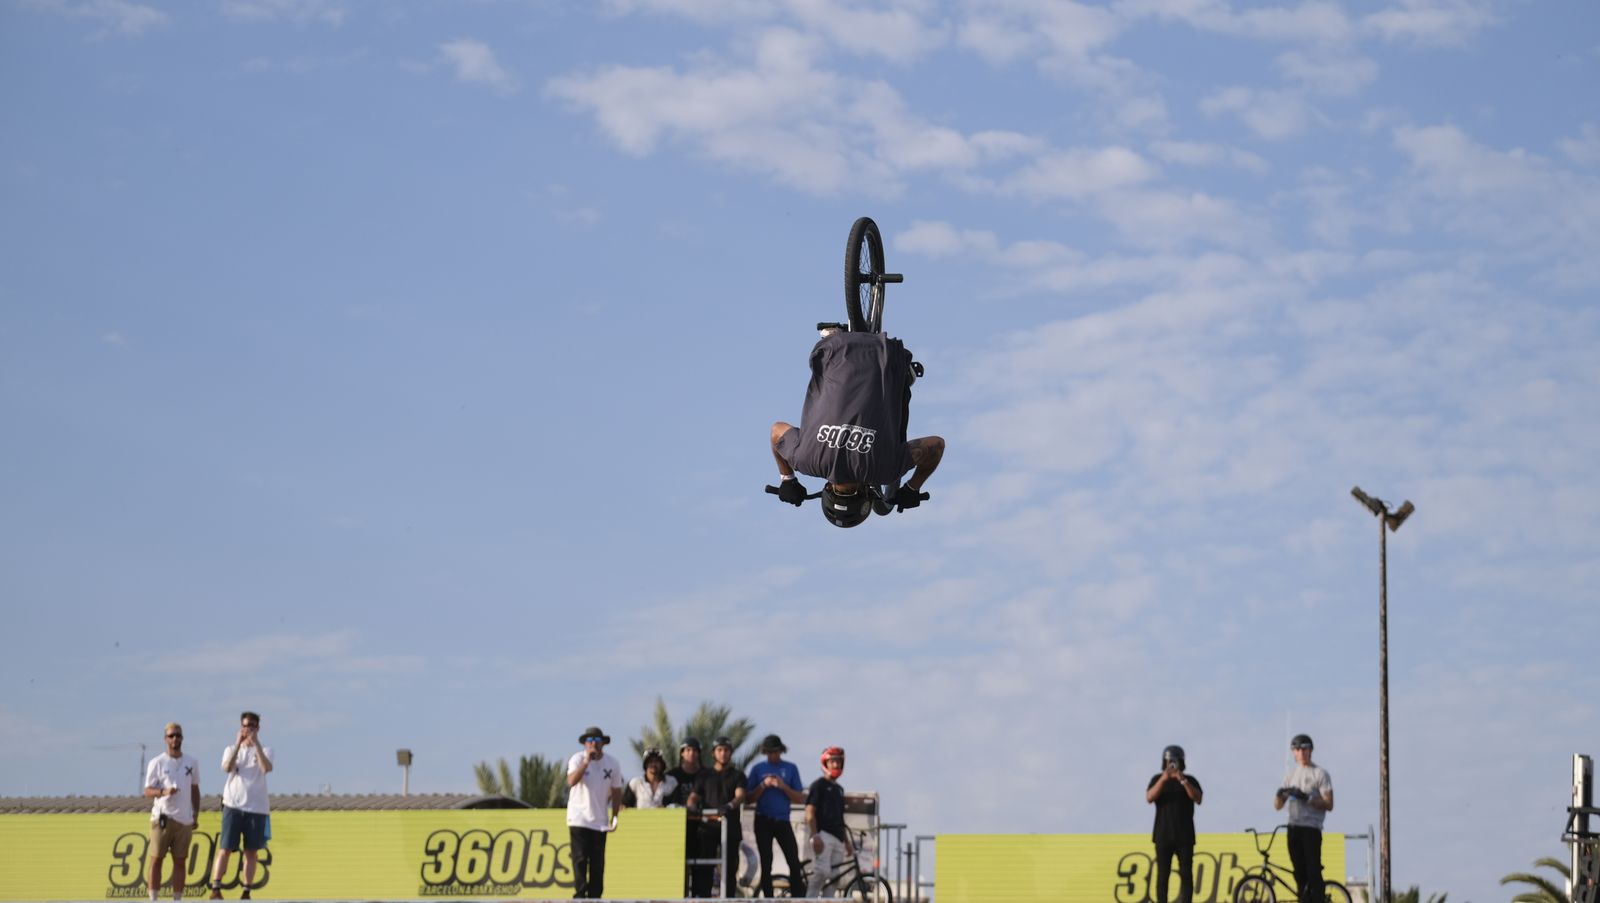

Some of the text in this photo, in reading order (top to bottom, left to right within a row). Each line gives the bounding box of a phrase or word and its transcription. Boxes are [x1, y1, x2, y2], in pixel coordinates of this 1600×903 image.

[817, 424, 875, 454] 360bs
[421, 829, 576, 888] 360bs
[182, 886, 207, 898] SHOP
